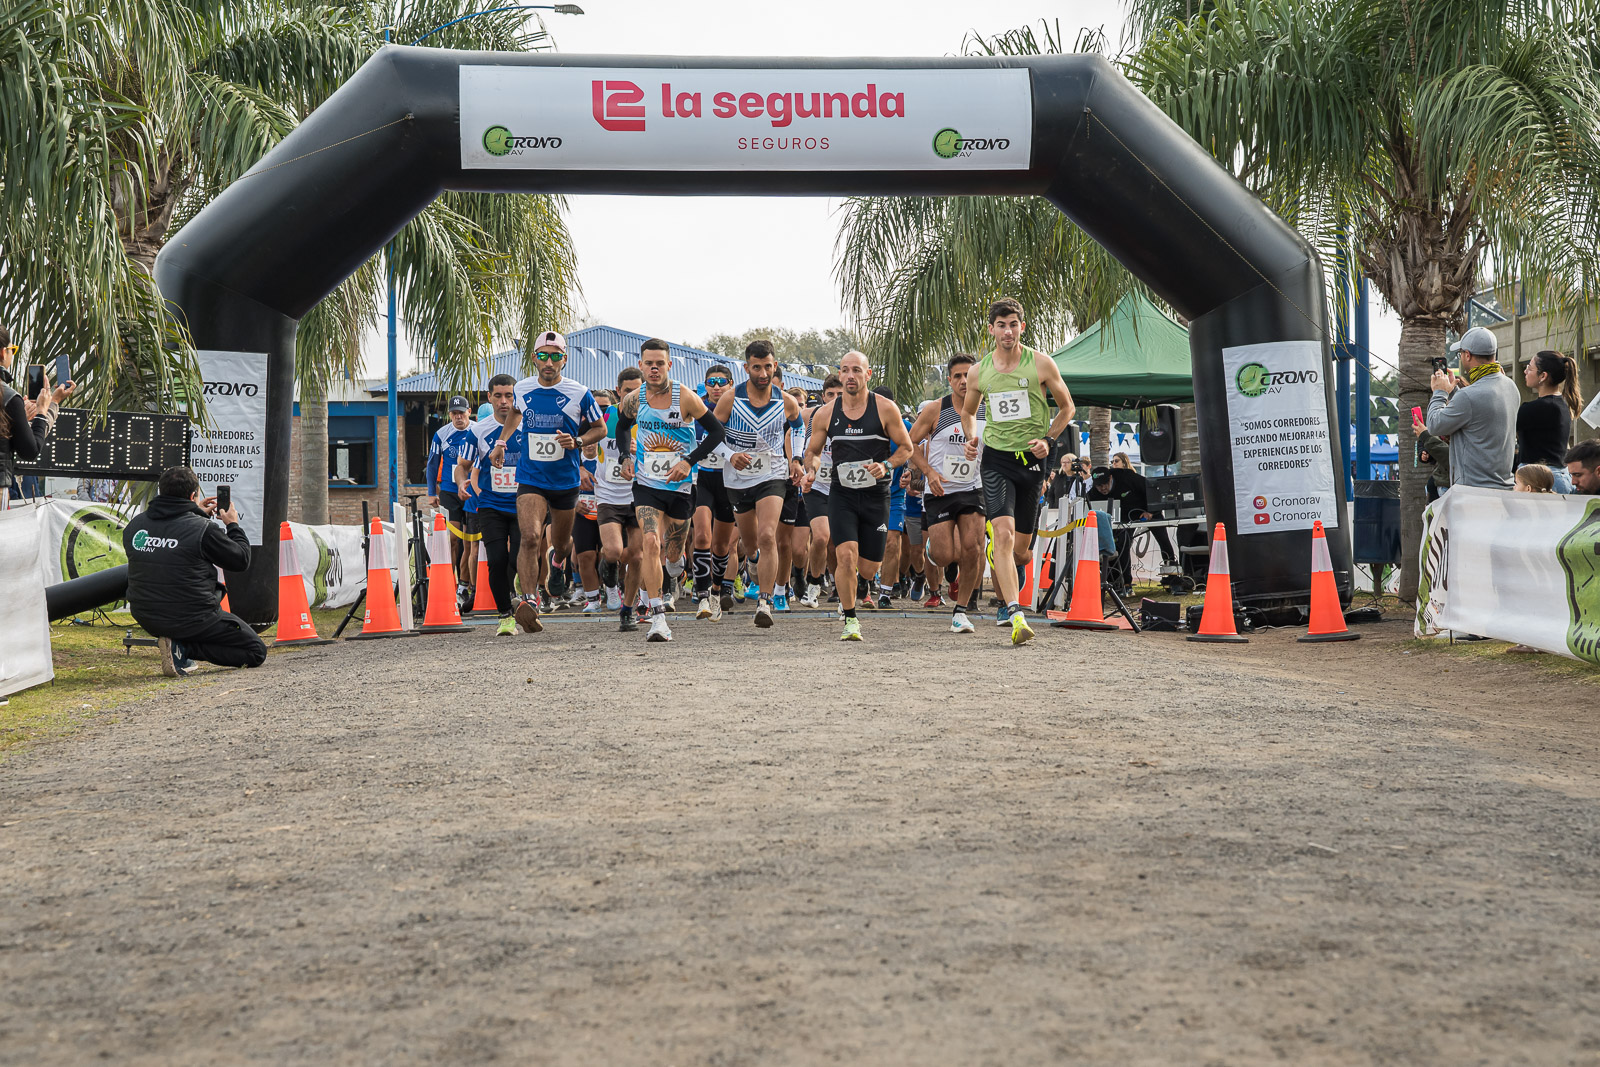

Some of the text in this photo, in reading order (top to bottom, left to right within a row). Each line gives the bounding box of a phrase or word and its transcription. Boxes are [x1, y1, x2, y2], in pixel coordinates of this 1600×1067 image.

[662, 83, 905, 127] la segunda
[504, 136, 562, 149] CRONO
[738, 137, 830, 150] SEGUROS
[953, 138, 1010, 150] CRONO
[1260, 370, 1318, 386] CRONO
[203, 382, 258, 397] RONO
[1260, 386, 1282, 395] RAV
[998, 399, 1020, 415] 83
[1273, 417, 1321, 428] CORREDORES
[1235, 433, 1278, 446] BUSCANDO
[1279, 431, 1316, 442] MEJORAR
[206, 444, 245, 454] MEJORAR
[246, 446, 260, 455] LAS
[535, 441, 556, 455] 20
[1243, 444, 1322, 459] EXPERIENCIAS DE LOS
[191, 458, 253, 469] IENCIAS DE LOS
[651, 459, 672, 474] 64
[951, 462, 970, 476] 70
[846, 468, 868, 483] 42
[1272, 496, 1321, 508] Cronorav
[1273, 511, 1322, 522] Cronorav
